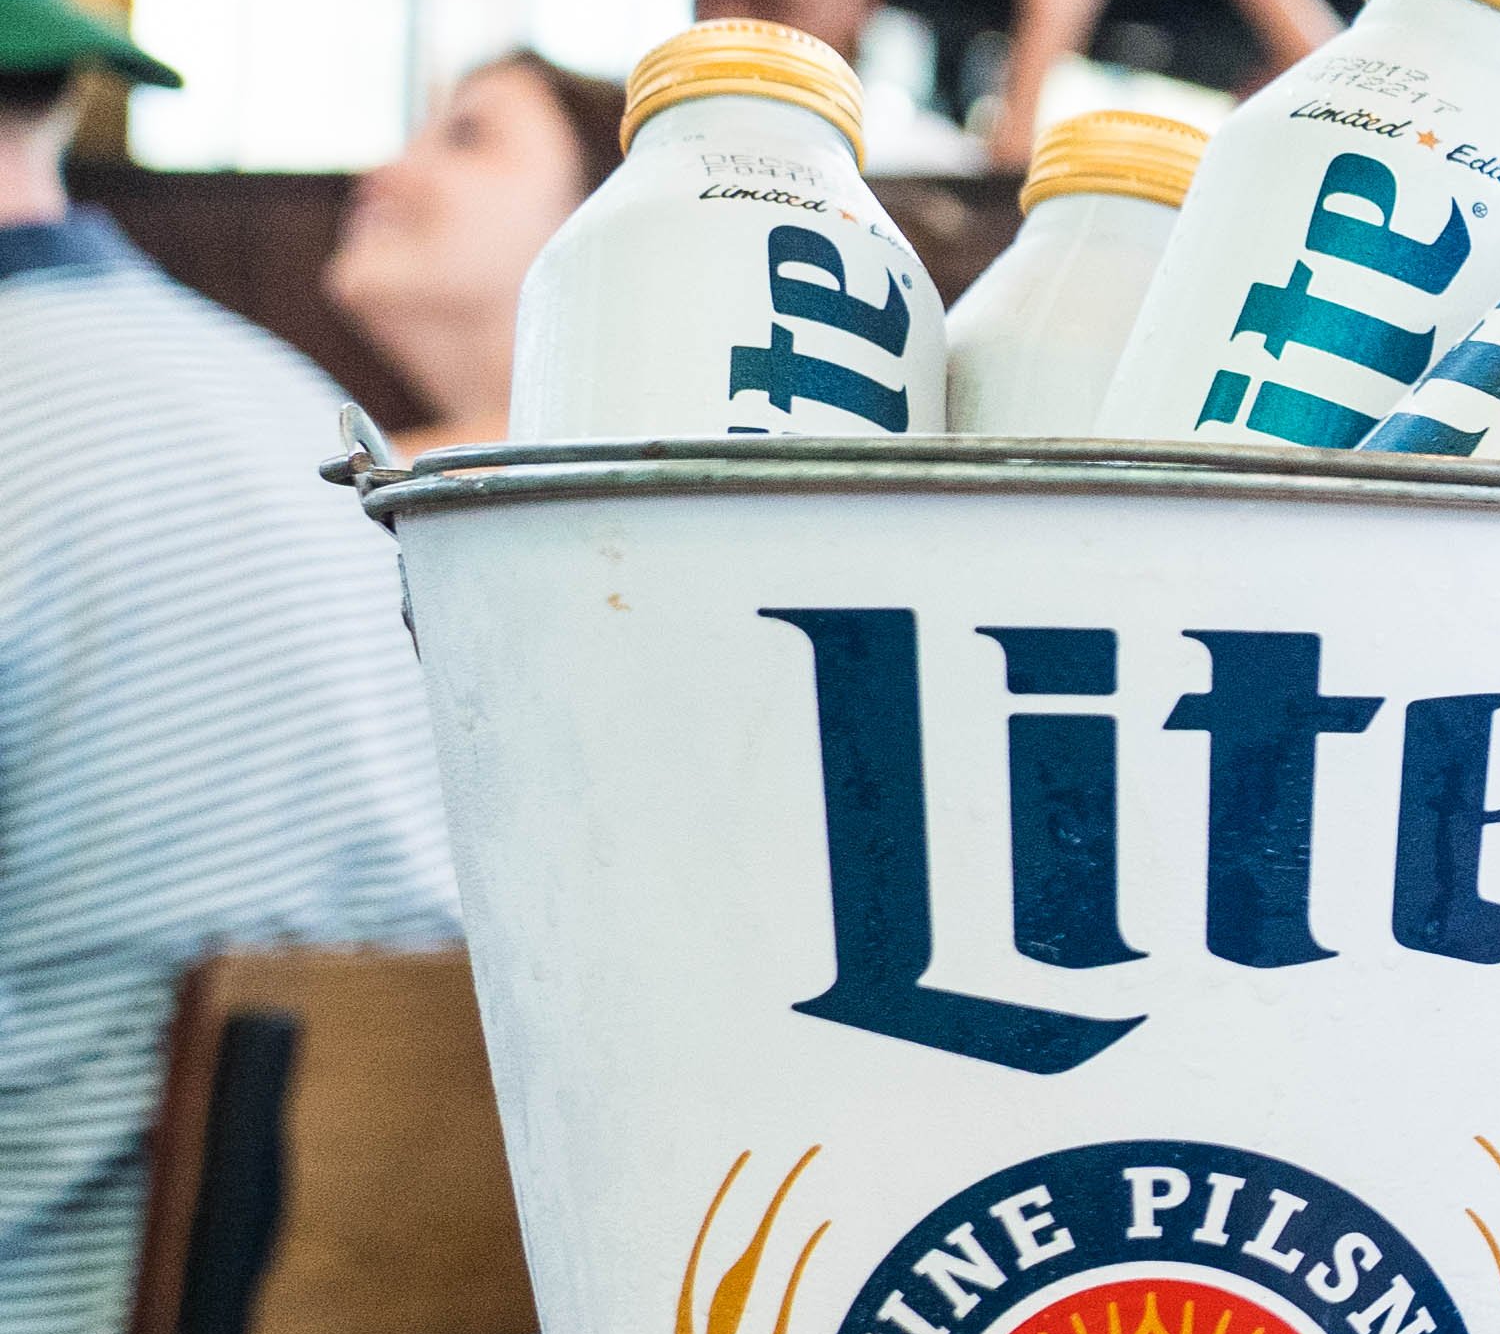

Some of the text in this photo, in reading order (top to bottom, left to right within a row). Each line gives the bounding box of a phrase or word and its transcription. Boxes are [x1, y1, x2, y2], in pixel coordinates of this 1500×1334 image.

[1289, 99, 1413, 139] Limited
[699, 183, 828, 213] Limited
[1195, 152, 1473, 450] ite
